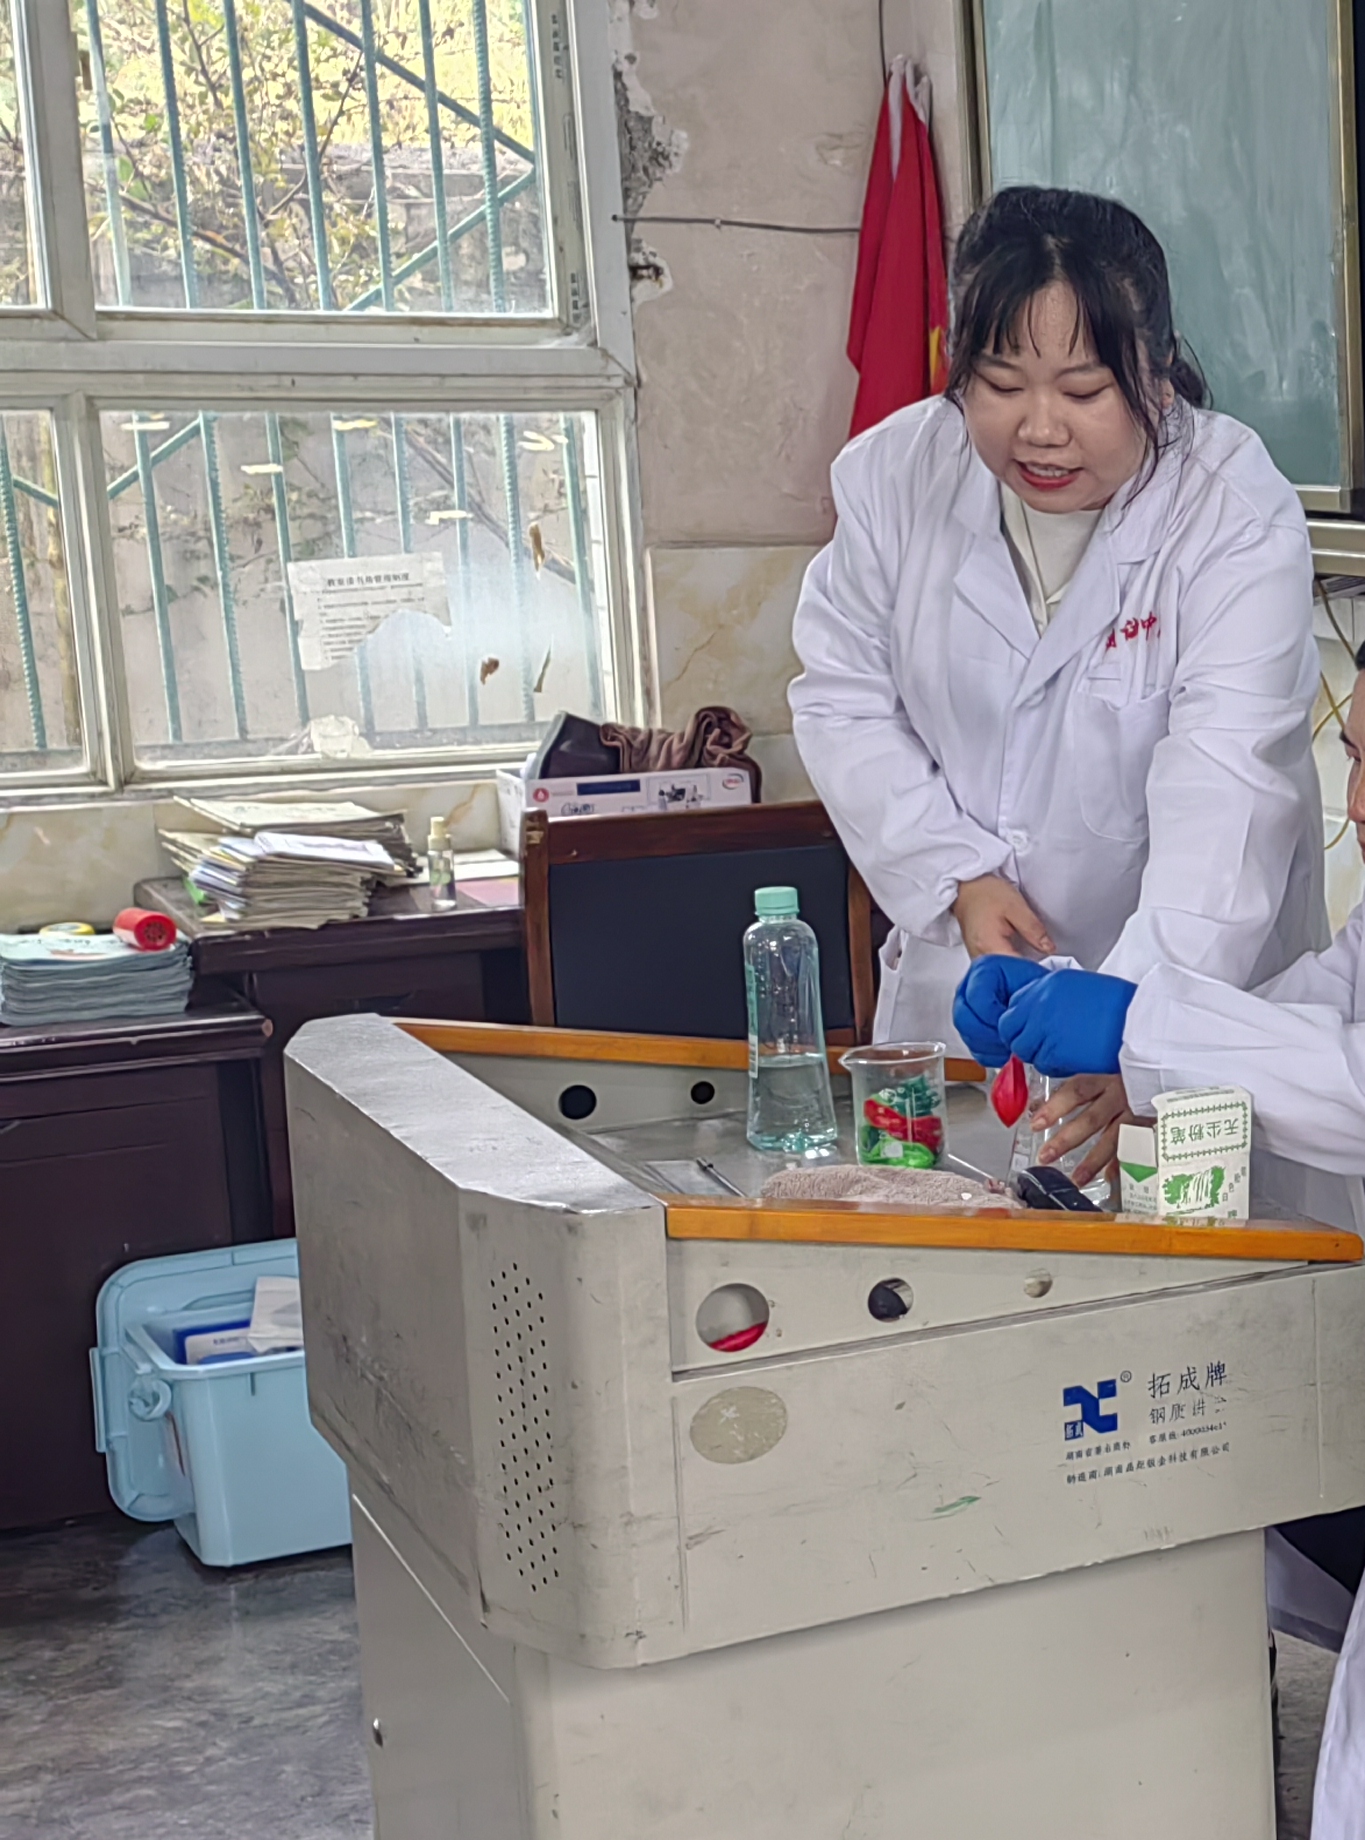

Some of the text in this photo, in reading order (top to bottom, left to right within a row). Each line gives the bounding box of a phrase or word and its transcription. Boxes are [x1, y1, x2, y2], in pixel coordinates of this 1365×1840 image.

[1169, 1117, 1239, 1145] 无尘粉笔
[1147, 1360, 1228, 1399] 拓成牌
[1148, 1396, 1228, 1425] 钢质讲
